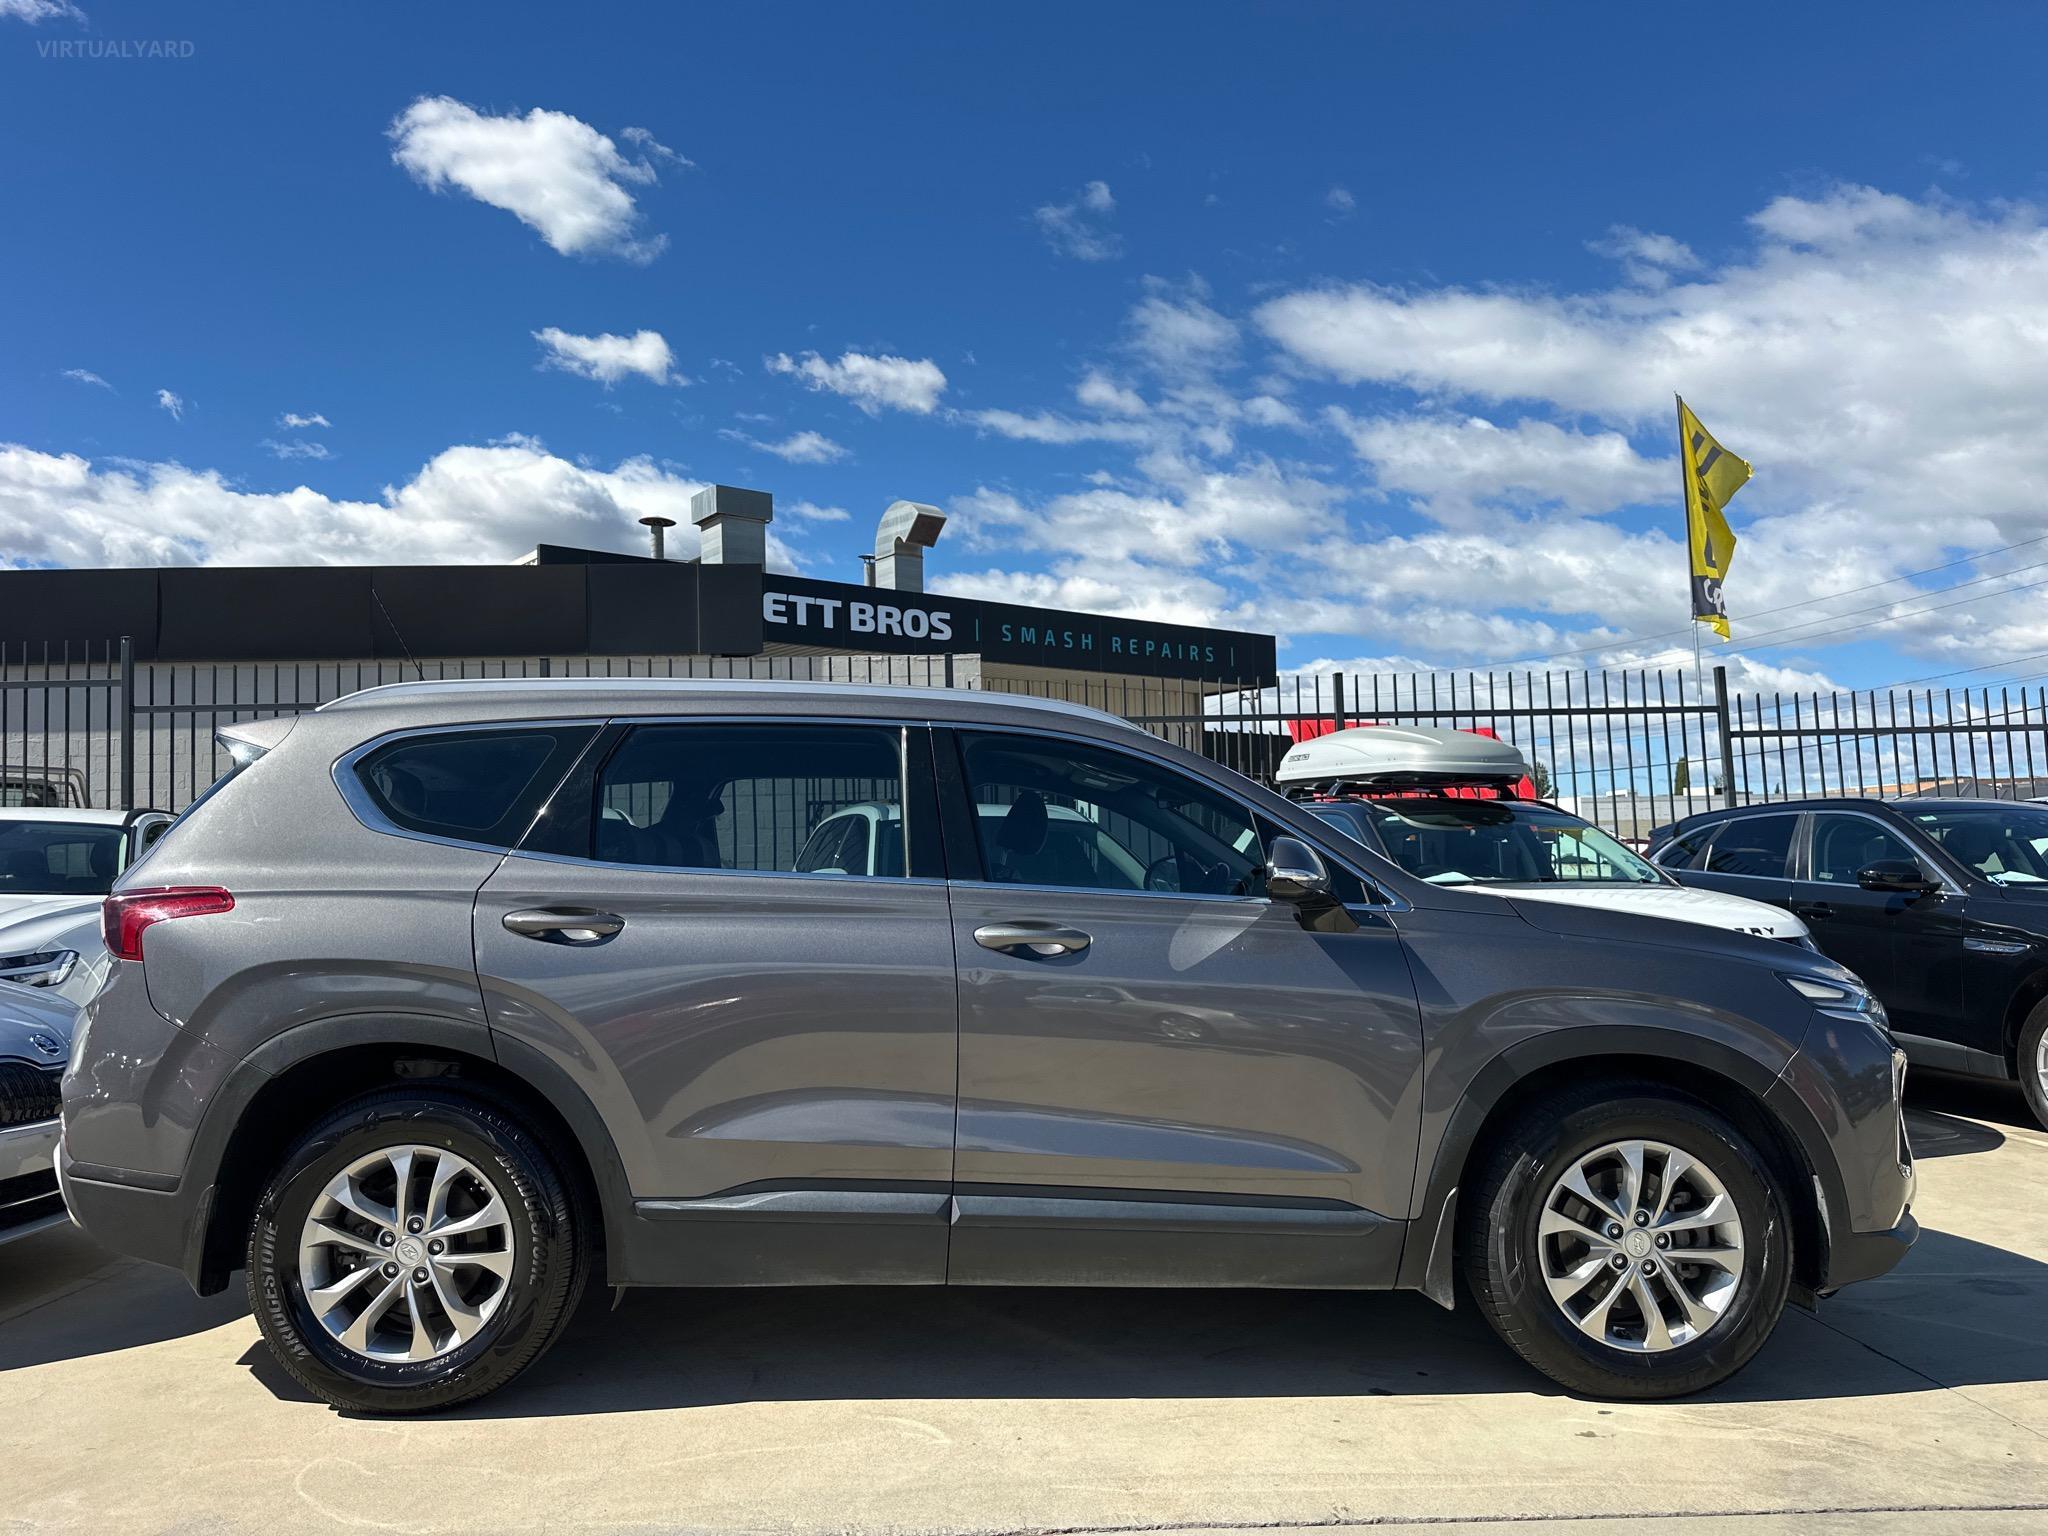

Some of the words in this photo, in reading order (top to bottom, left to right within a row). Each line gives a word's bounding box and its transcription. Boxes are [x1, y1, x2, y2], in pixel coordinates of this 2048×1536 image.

[763, 592, 842, 629] ETT
[849, 602, 953, 641] BROS
[1002, 624, 1092, 650] SMASH
[1111, 637, 1214, 662] REPAIRS
[261, 1219, 312, 1361] BRIDGESTONE
